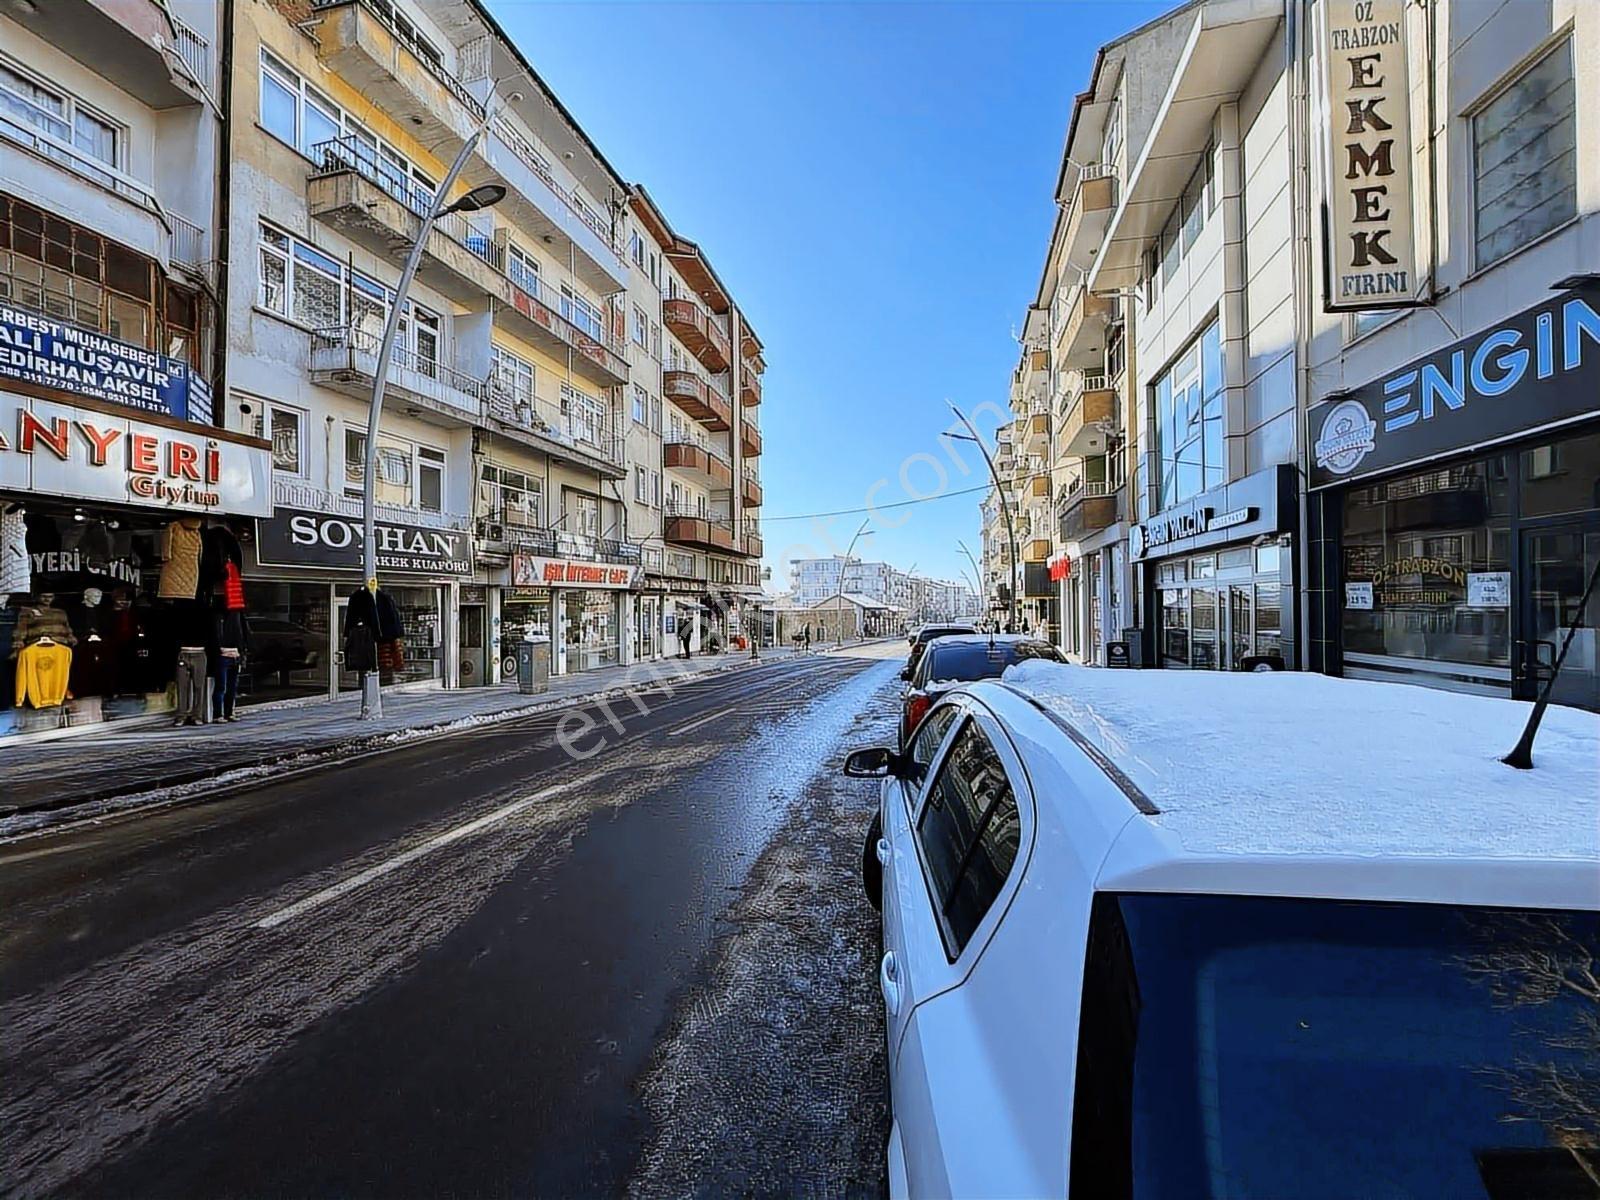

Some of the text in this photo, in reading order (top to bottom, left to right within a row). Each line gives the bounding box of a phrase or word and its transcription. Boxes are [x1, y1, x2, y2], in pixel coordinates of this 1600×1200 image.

[1331, 22, 1400, 50] TRABZON
[1345, 53, 1398, 267] EKMEK
[1342, 271, 1408, 297] FIRINI
[0, 307, 60, 337] RBEST
[53, 341, 170, 388] MÜŞAVİR
[103, 375, 162, 403] AKSEL
[0, 408, 221, 485] NYERİ
